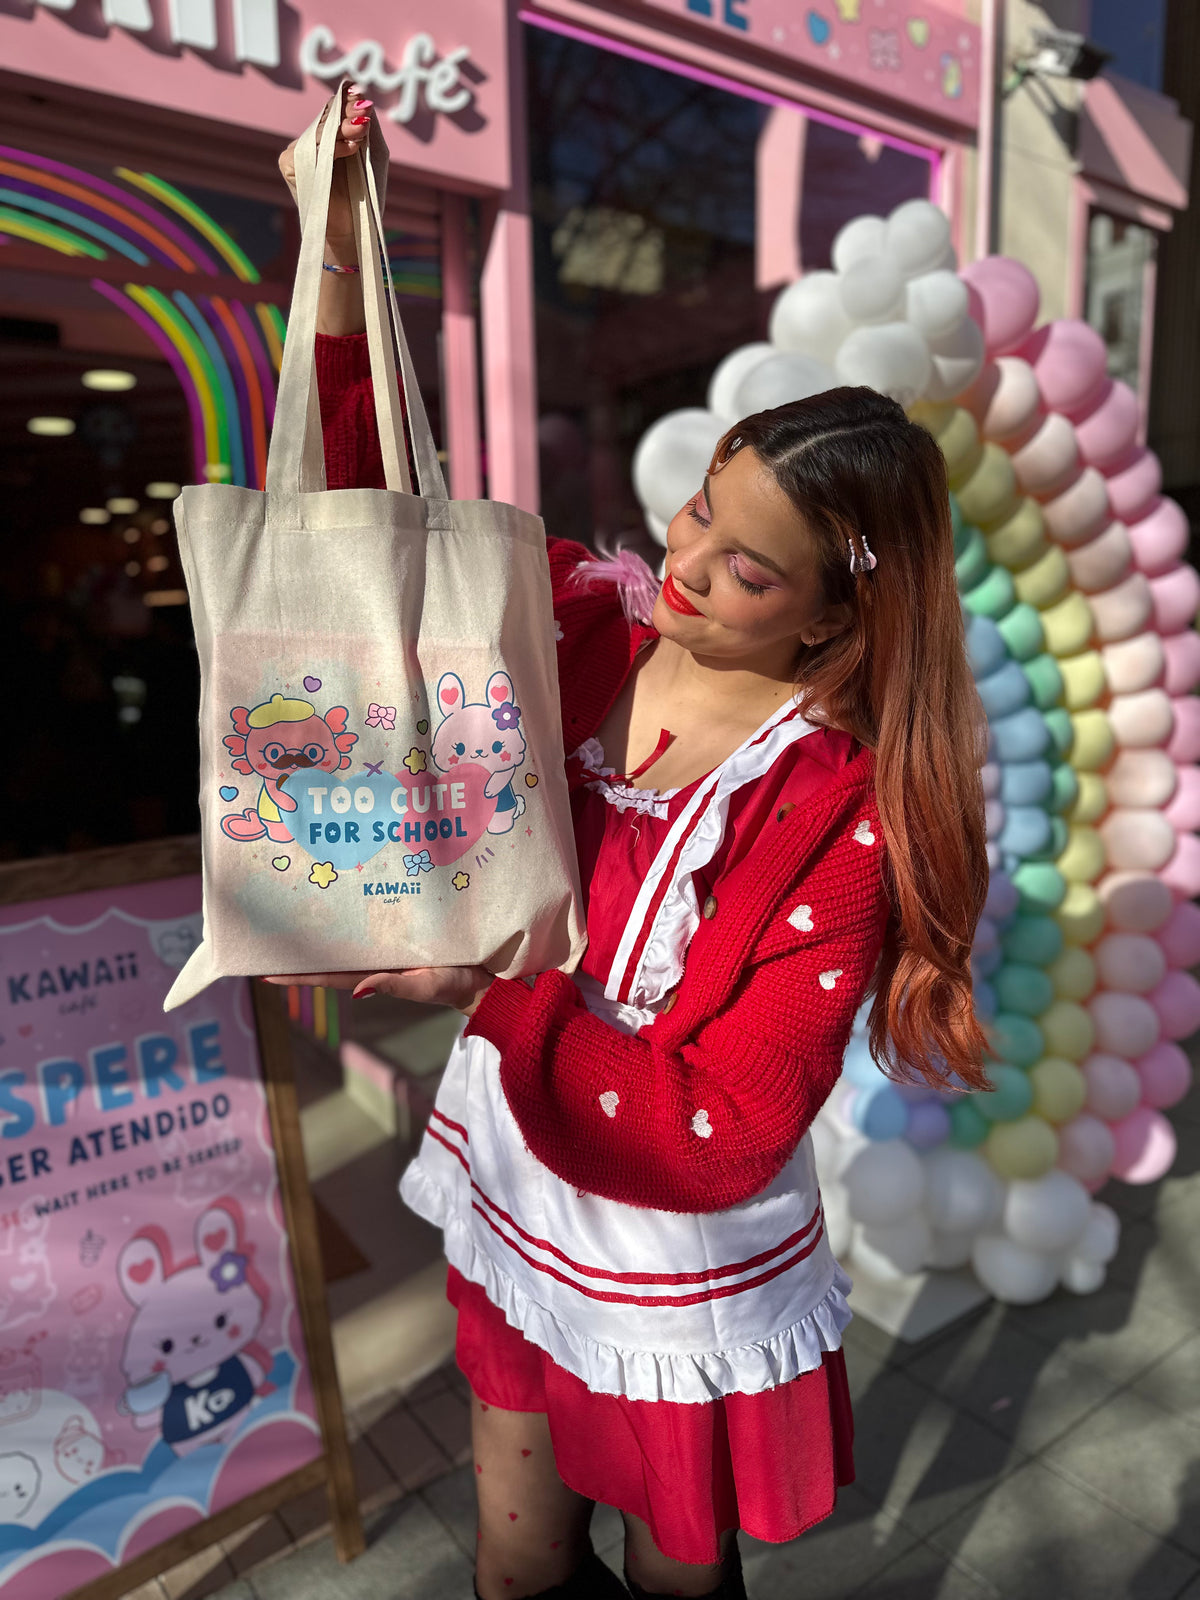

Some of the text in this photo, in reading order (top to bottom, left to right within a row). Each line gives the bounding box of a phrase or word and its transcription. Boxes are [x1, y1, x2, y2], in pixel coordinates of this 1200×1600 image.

[300, 25, 471, 123] café
[308, 783, 466, 815] TOO CUTE
[308, 817, 468, 845] FOR SCHOOL
[135, 1164, 157, 1184] TO
[162, 1155, 182, 1175] BE
